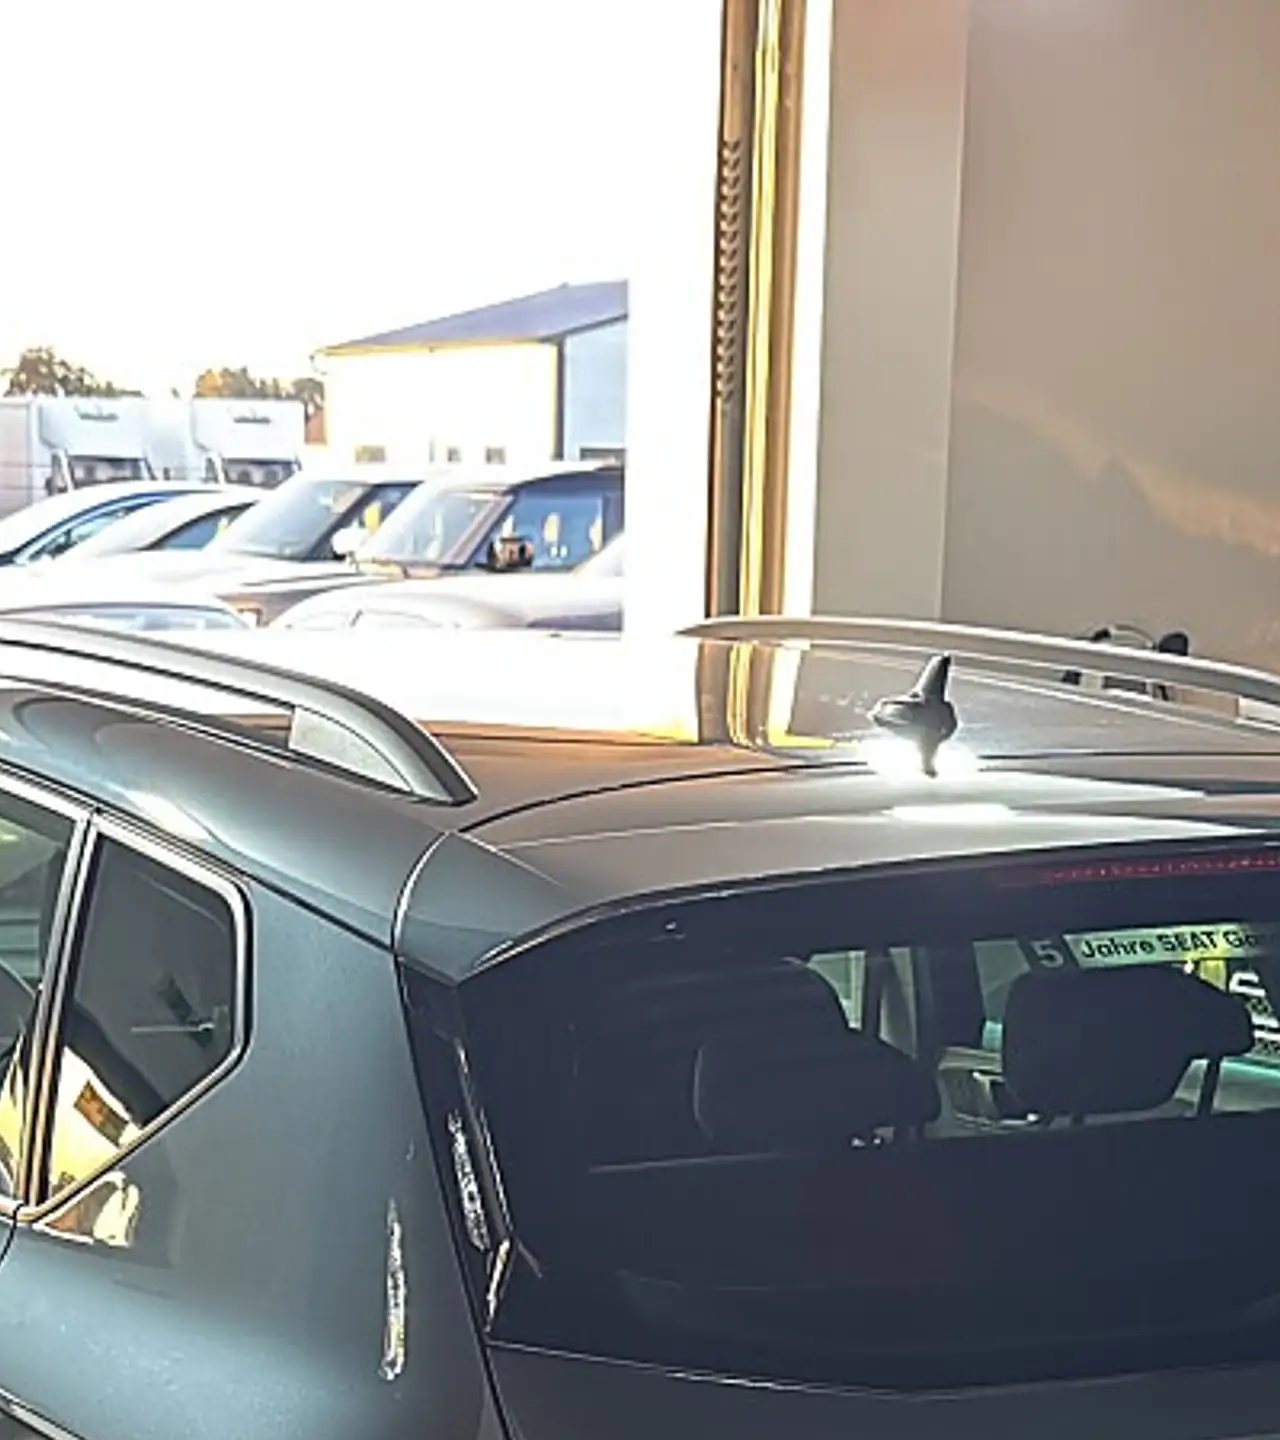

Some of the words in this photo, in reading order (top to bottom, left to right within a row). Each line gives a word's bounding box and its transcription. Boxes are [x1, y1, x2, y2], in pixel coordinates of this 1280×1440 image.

[1029, 940, 1064, 968] 5
[1081, 936, 1156, 958] Jahre
[1156, 931, 1219, 953] SEAT
